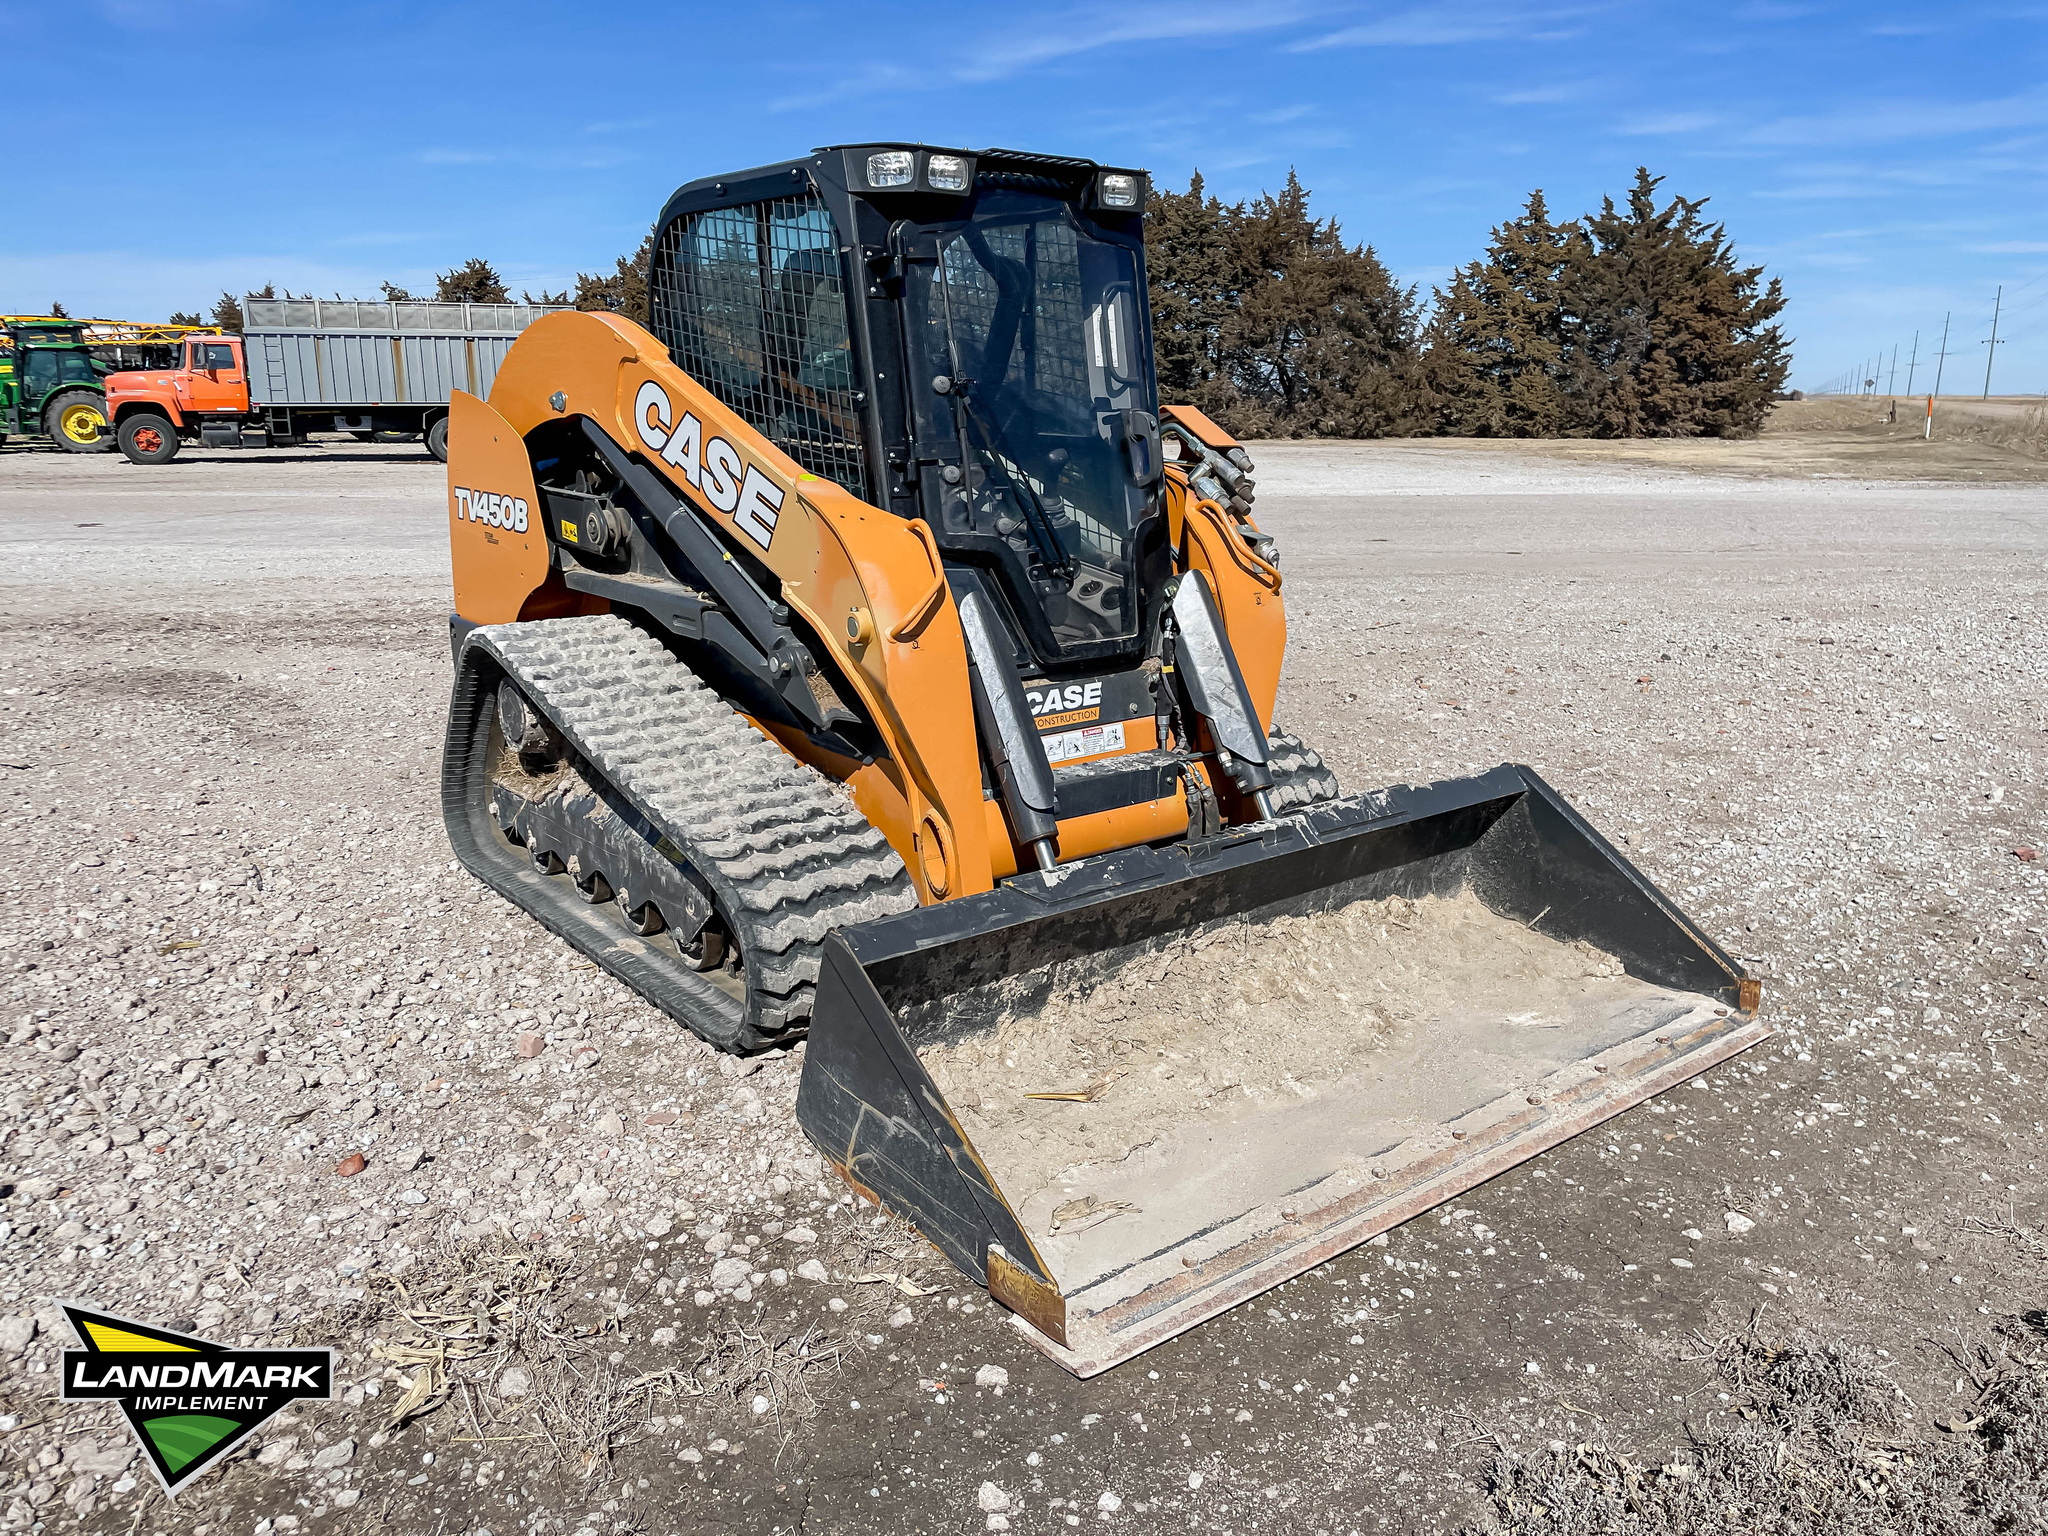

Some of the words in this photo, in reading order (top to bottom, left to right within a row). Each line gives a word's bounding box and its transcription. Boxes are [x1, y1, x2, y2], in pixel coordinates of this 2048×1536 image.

[634, 379, 786, 552] CASE
[454, 486, 528, 533] TV450B
[1026, 682, 1102, 716] CASE
[1035, 709, 1097, 727] ONSTRUCTION
